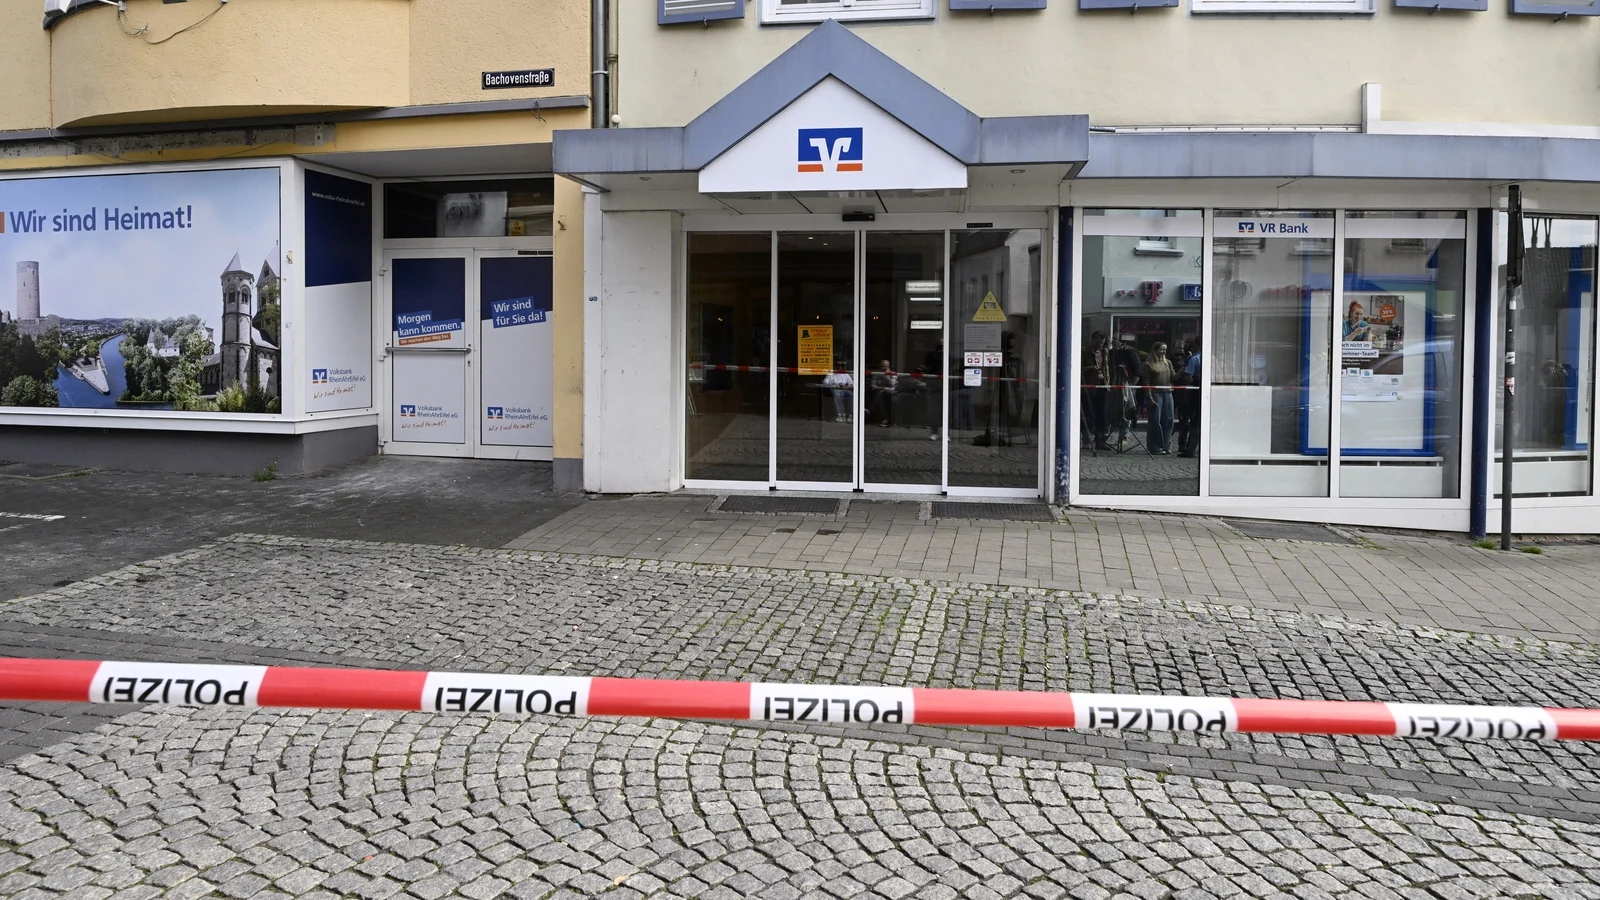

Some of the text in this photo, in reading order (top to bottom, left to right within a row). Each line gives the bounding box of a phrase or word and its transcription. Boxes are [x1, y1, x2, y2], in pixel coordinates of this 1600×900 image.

[485, 71, 549, 85] Bachovenstraße
[9, 205, 192, 233] Wir sind Heimat!
[1260, 222, 1308, 233] VR Bank
[493, 298, 532, 313] Wir sind
[397, 313, 431, 325] Morgen
[496, 311, 543, 326] für Sie da!
[399, 322, 460, 336] kann kommen.
[424, 420, 447, 428] Heimat!
[513, 421, 536, 429] Heimat!
[103, 676, 249, 706] POLIZEI
[435, 687, 577, 714] POLIZEI
[764, 697, 903, 724] POLIZEI
[1088, 706, 1226, 733] POLIZEI
[1409, 716, 1546, 740] POLIZEI
